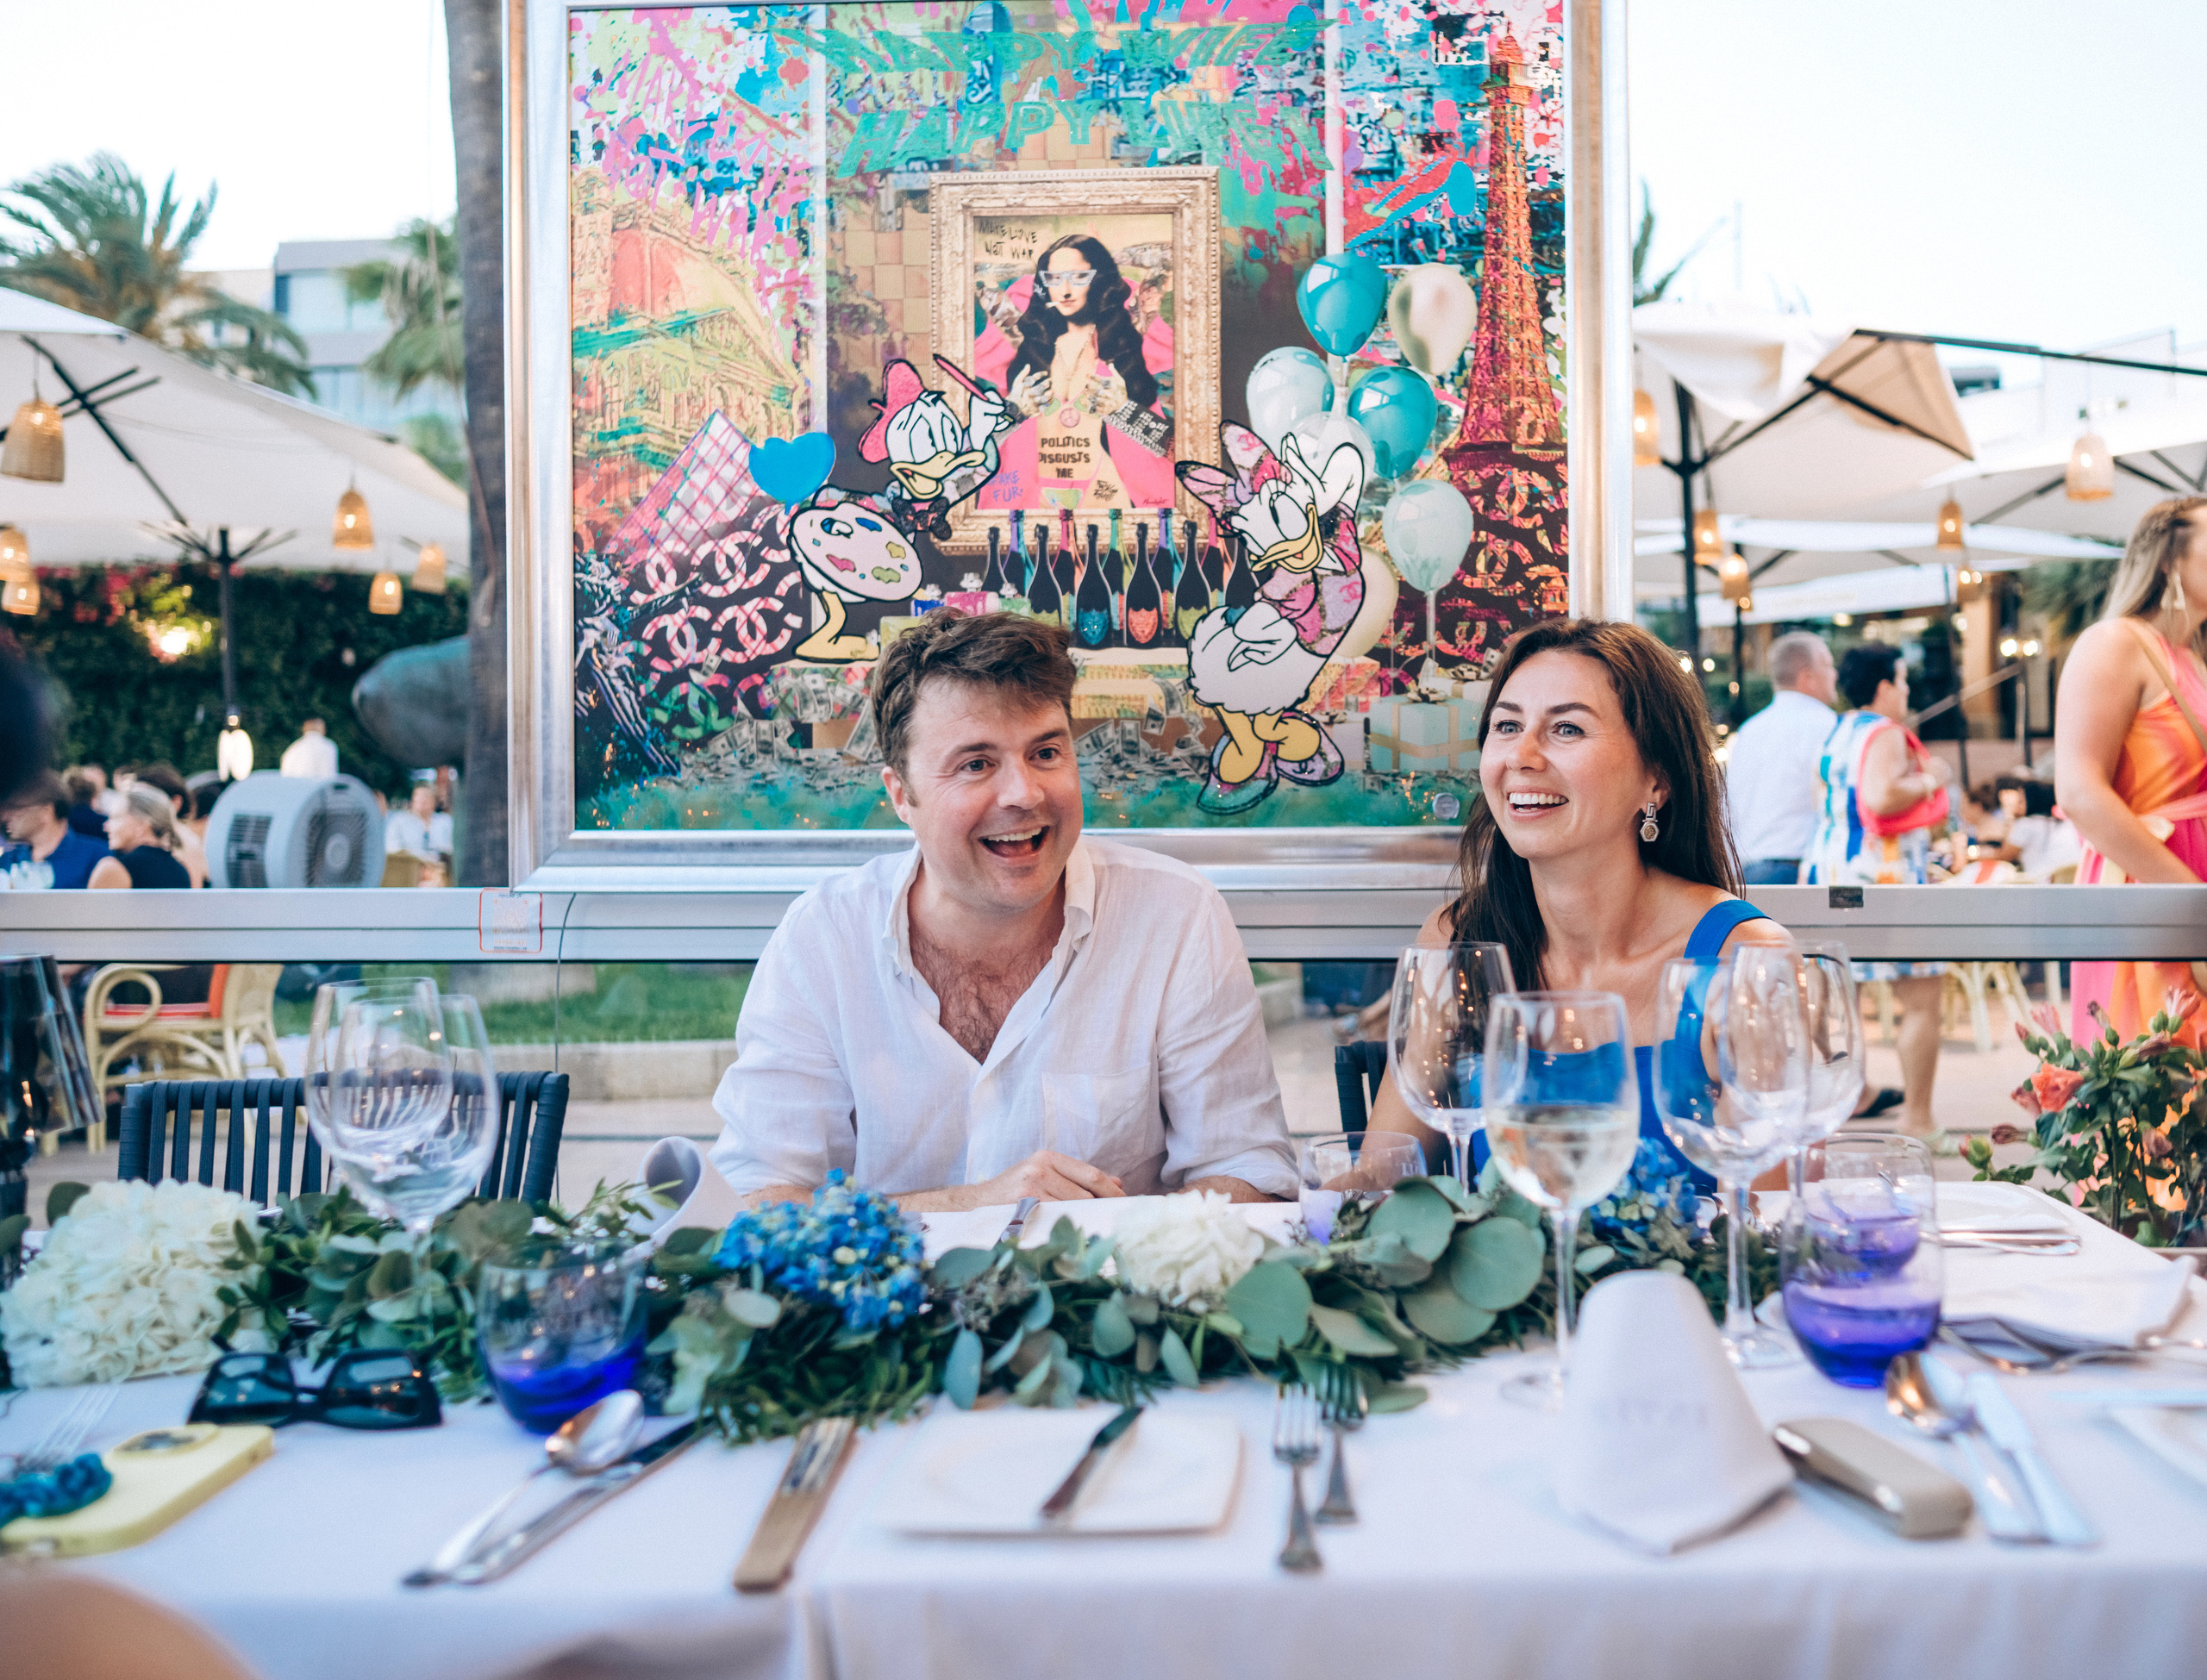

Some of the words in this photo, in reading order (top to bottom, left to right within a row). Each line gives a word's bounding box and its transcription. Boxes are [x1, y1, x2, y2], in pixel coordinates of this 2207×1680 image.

[837, 99, 1102, 180] HAPPY
[1041, 436, 1090, 448] POLITICS
[1038, 452, 1091, 464] DISGUSTS
